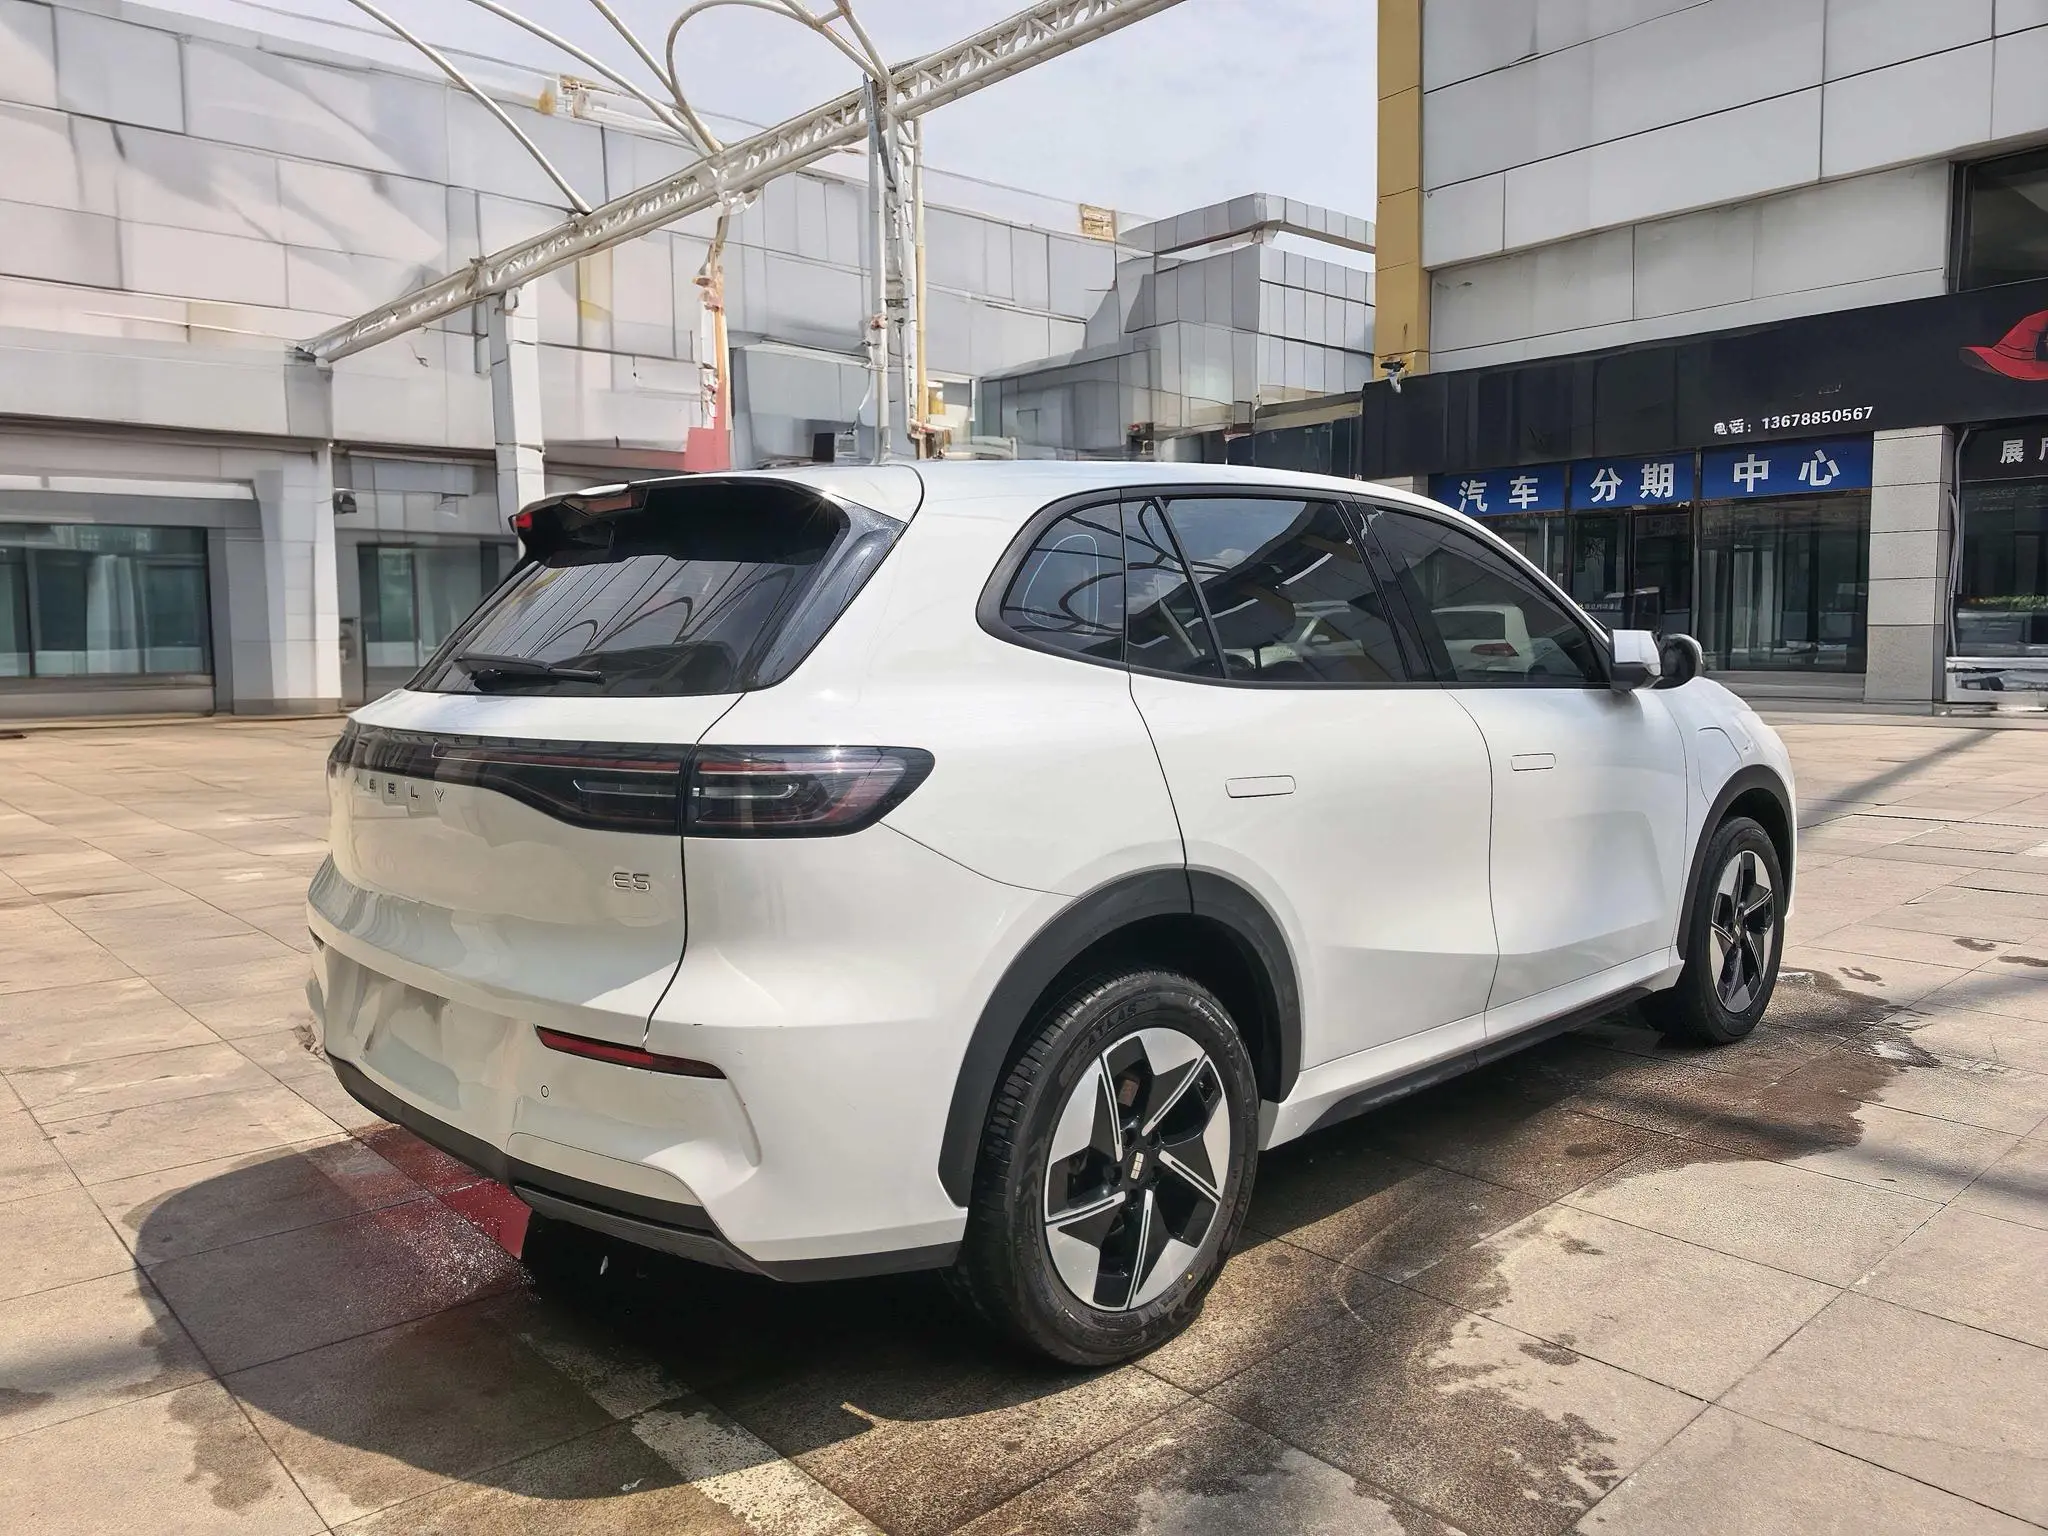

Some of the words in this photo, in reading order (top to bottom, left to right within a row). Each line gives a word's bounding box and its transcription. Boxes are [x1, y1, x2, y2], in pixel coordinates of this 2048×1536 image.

[1761, 406, 1874, 430] 13678850567
[1590, 463, 1675, 503] 分期
[1733, 449, 1841, 493] 中心
